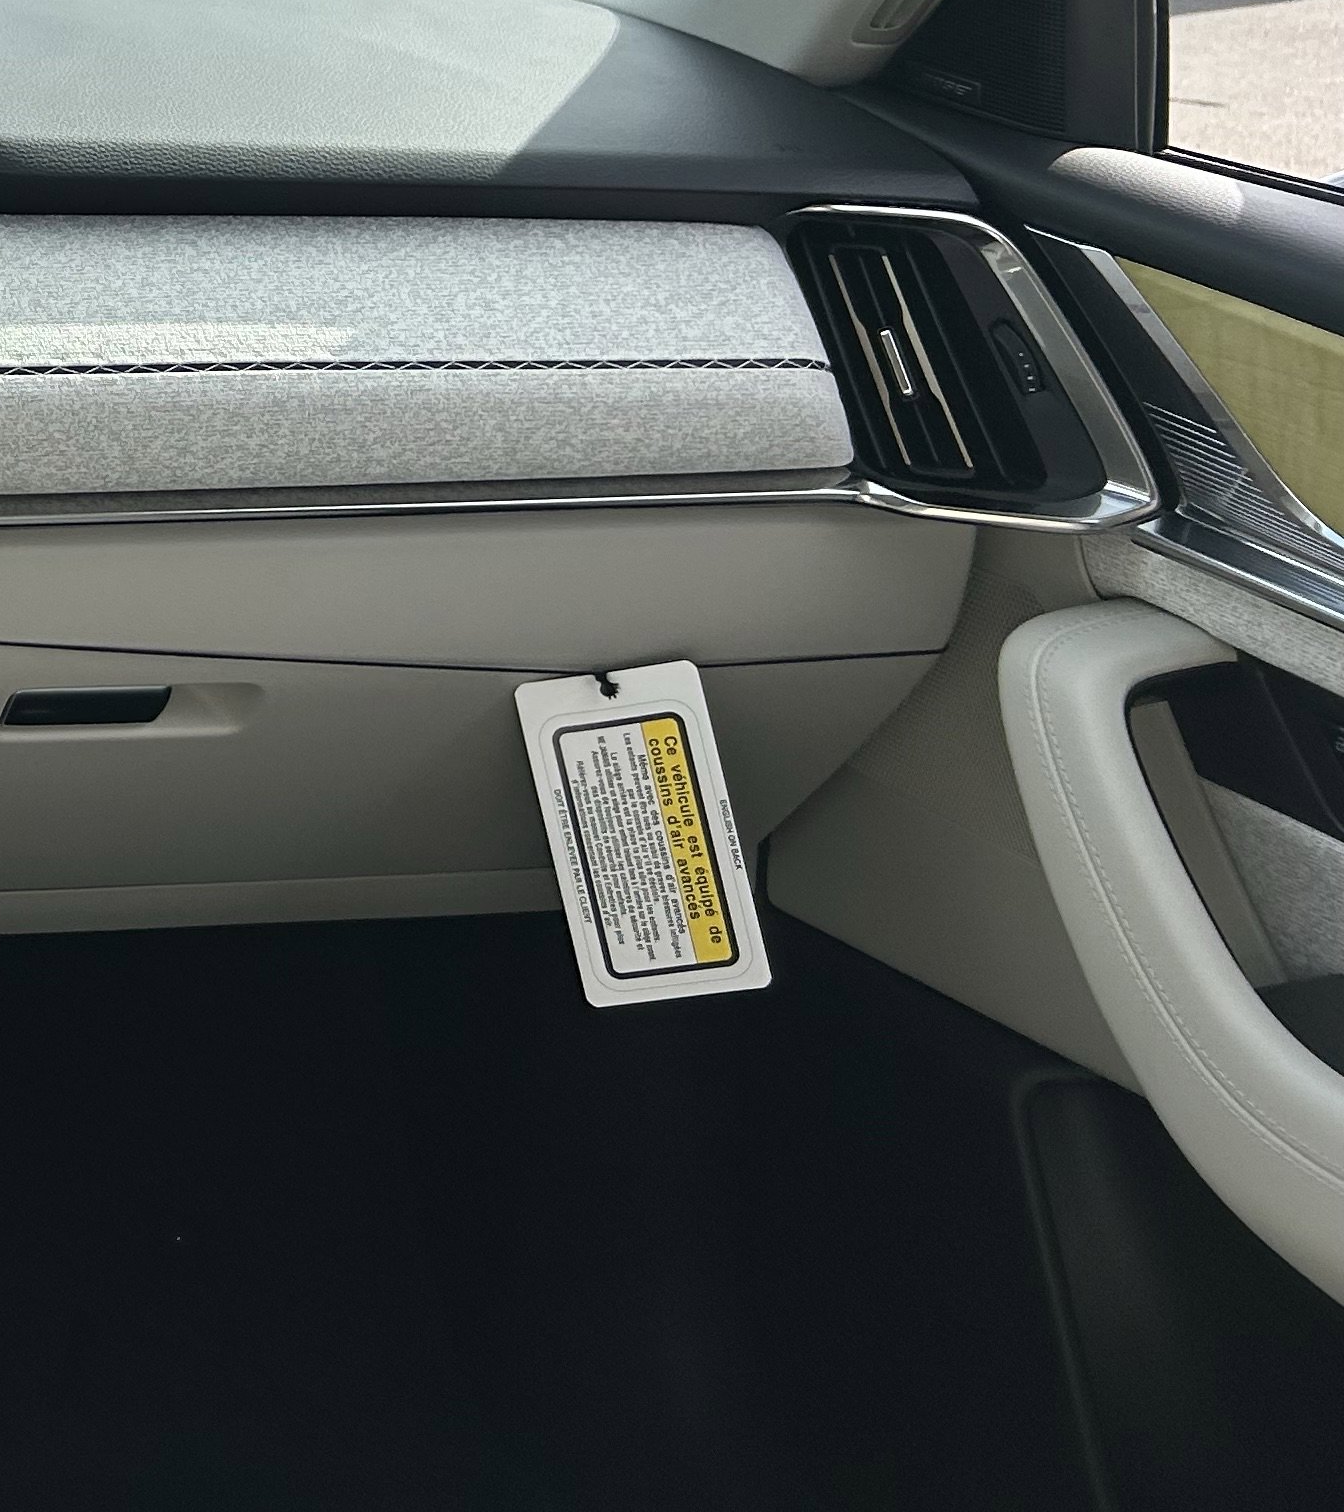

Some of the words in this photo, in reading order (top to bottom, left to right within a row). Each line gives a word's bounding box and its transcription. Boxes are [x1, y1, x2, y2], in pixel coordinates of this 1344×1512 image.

[622, 732, 632, 745] Les
[662, 735, 679, 755] Ce
[609, 751, 618, 760] Le
[625, 746, 638, 771] enfants
[610, 762, 623, 781] siège
[616, 782, 629, 805] arrière
[630, 772, 645, 799] peuvent
[643, 784, 655, 805] avec
[552, 788, 565, 807] DOIT
[669, 764, 697, 827] véhicule
[622, 806, 631, 817] est
[649, 809, 661, 825] des
[718, 798, 734, 834] ENGLISH
[626, 826, 638, 845] place
[645, 832, 654, 840] ou
[647, 737, 676, 806] coussins
[665, 814, 686, 849] d'air
[676, 857, 704, 919] avancés
[648, 842, 658, 859] subir
[654, 830, 671, 869] coussins
[686, 835, 703, 858] est
[726, 834, 738, 848] ON
[633, 855, 644, 869] plus
[652, 860, 661, 869] de
[729, 848, 743, 870] BACK
[571, 867, 583, 883] PAR
[653, 870, 666, 893] graves
[664, 874, 678, 893] d'air
[575, 884, 585, 894] LE
[640, 887, 651, 902] pour
[690, 865, 718, 917] équipé
[577, 895, 592, 924] CLIENT
[645, 904, 654, 914] les
[660, 894, 675, 927] blessures
[670, 898, 687, 934] avancés
[667, 928, 683, 958] infligées
[708, 925, 723, 944] de
